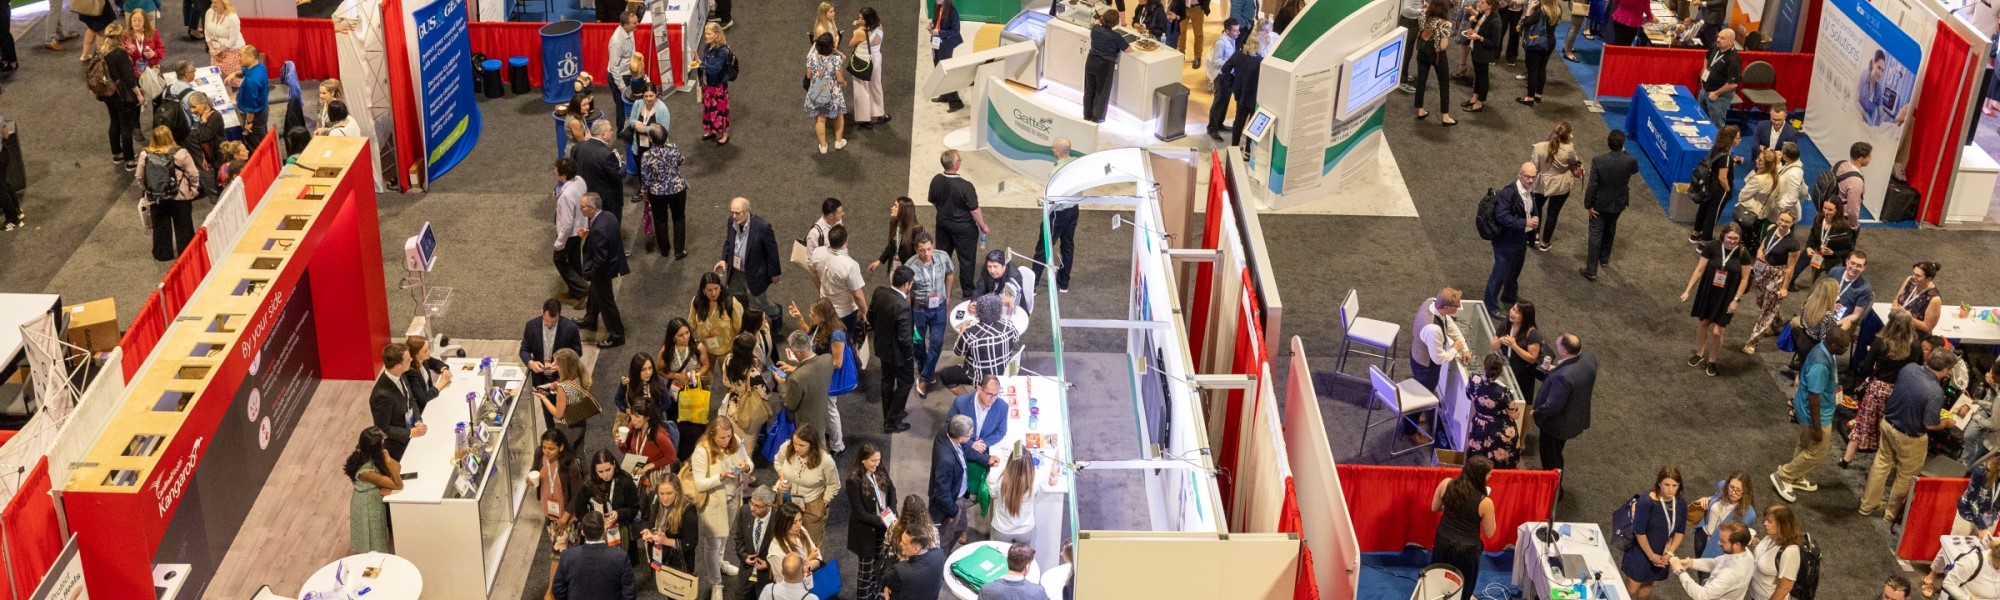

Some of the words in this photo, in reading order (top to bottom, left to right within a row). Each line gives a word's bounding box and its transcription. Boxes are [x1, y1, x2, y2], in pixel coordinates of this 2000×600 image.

[418, 15, 436, 40] GUS
[1830, 24, 1859, 61] Solutions
[1013, 108, 1050, 134] Gattex
[241, 337, 252, 360] By
[251, 312, 269, 350] your
[268, 290, 283, 319] side
[158, 446, 200, 519] Kangaroo
[63, 573, 80, 599] Heals
